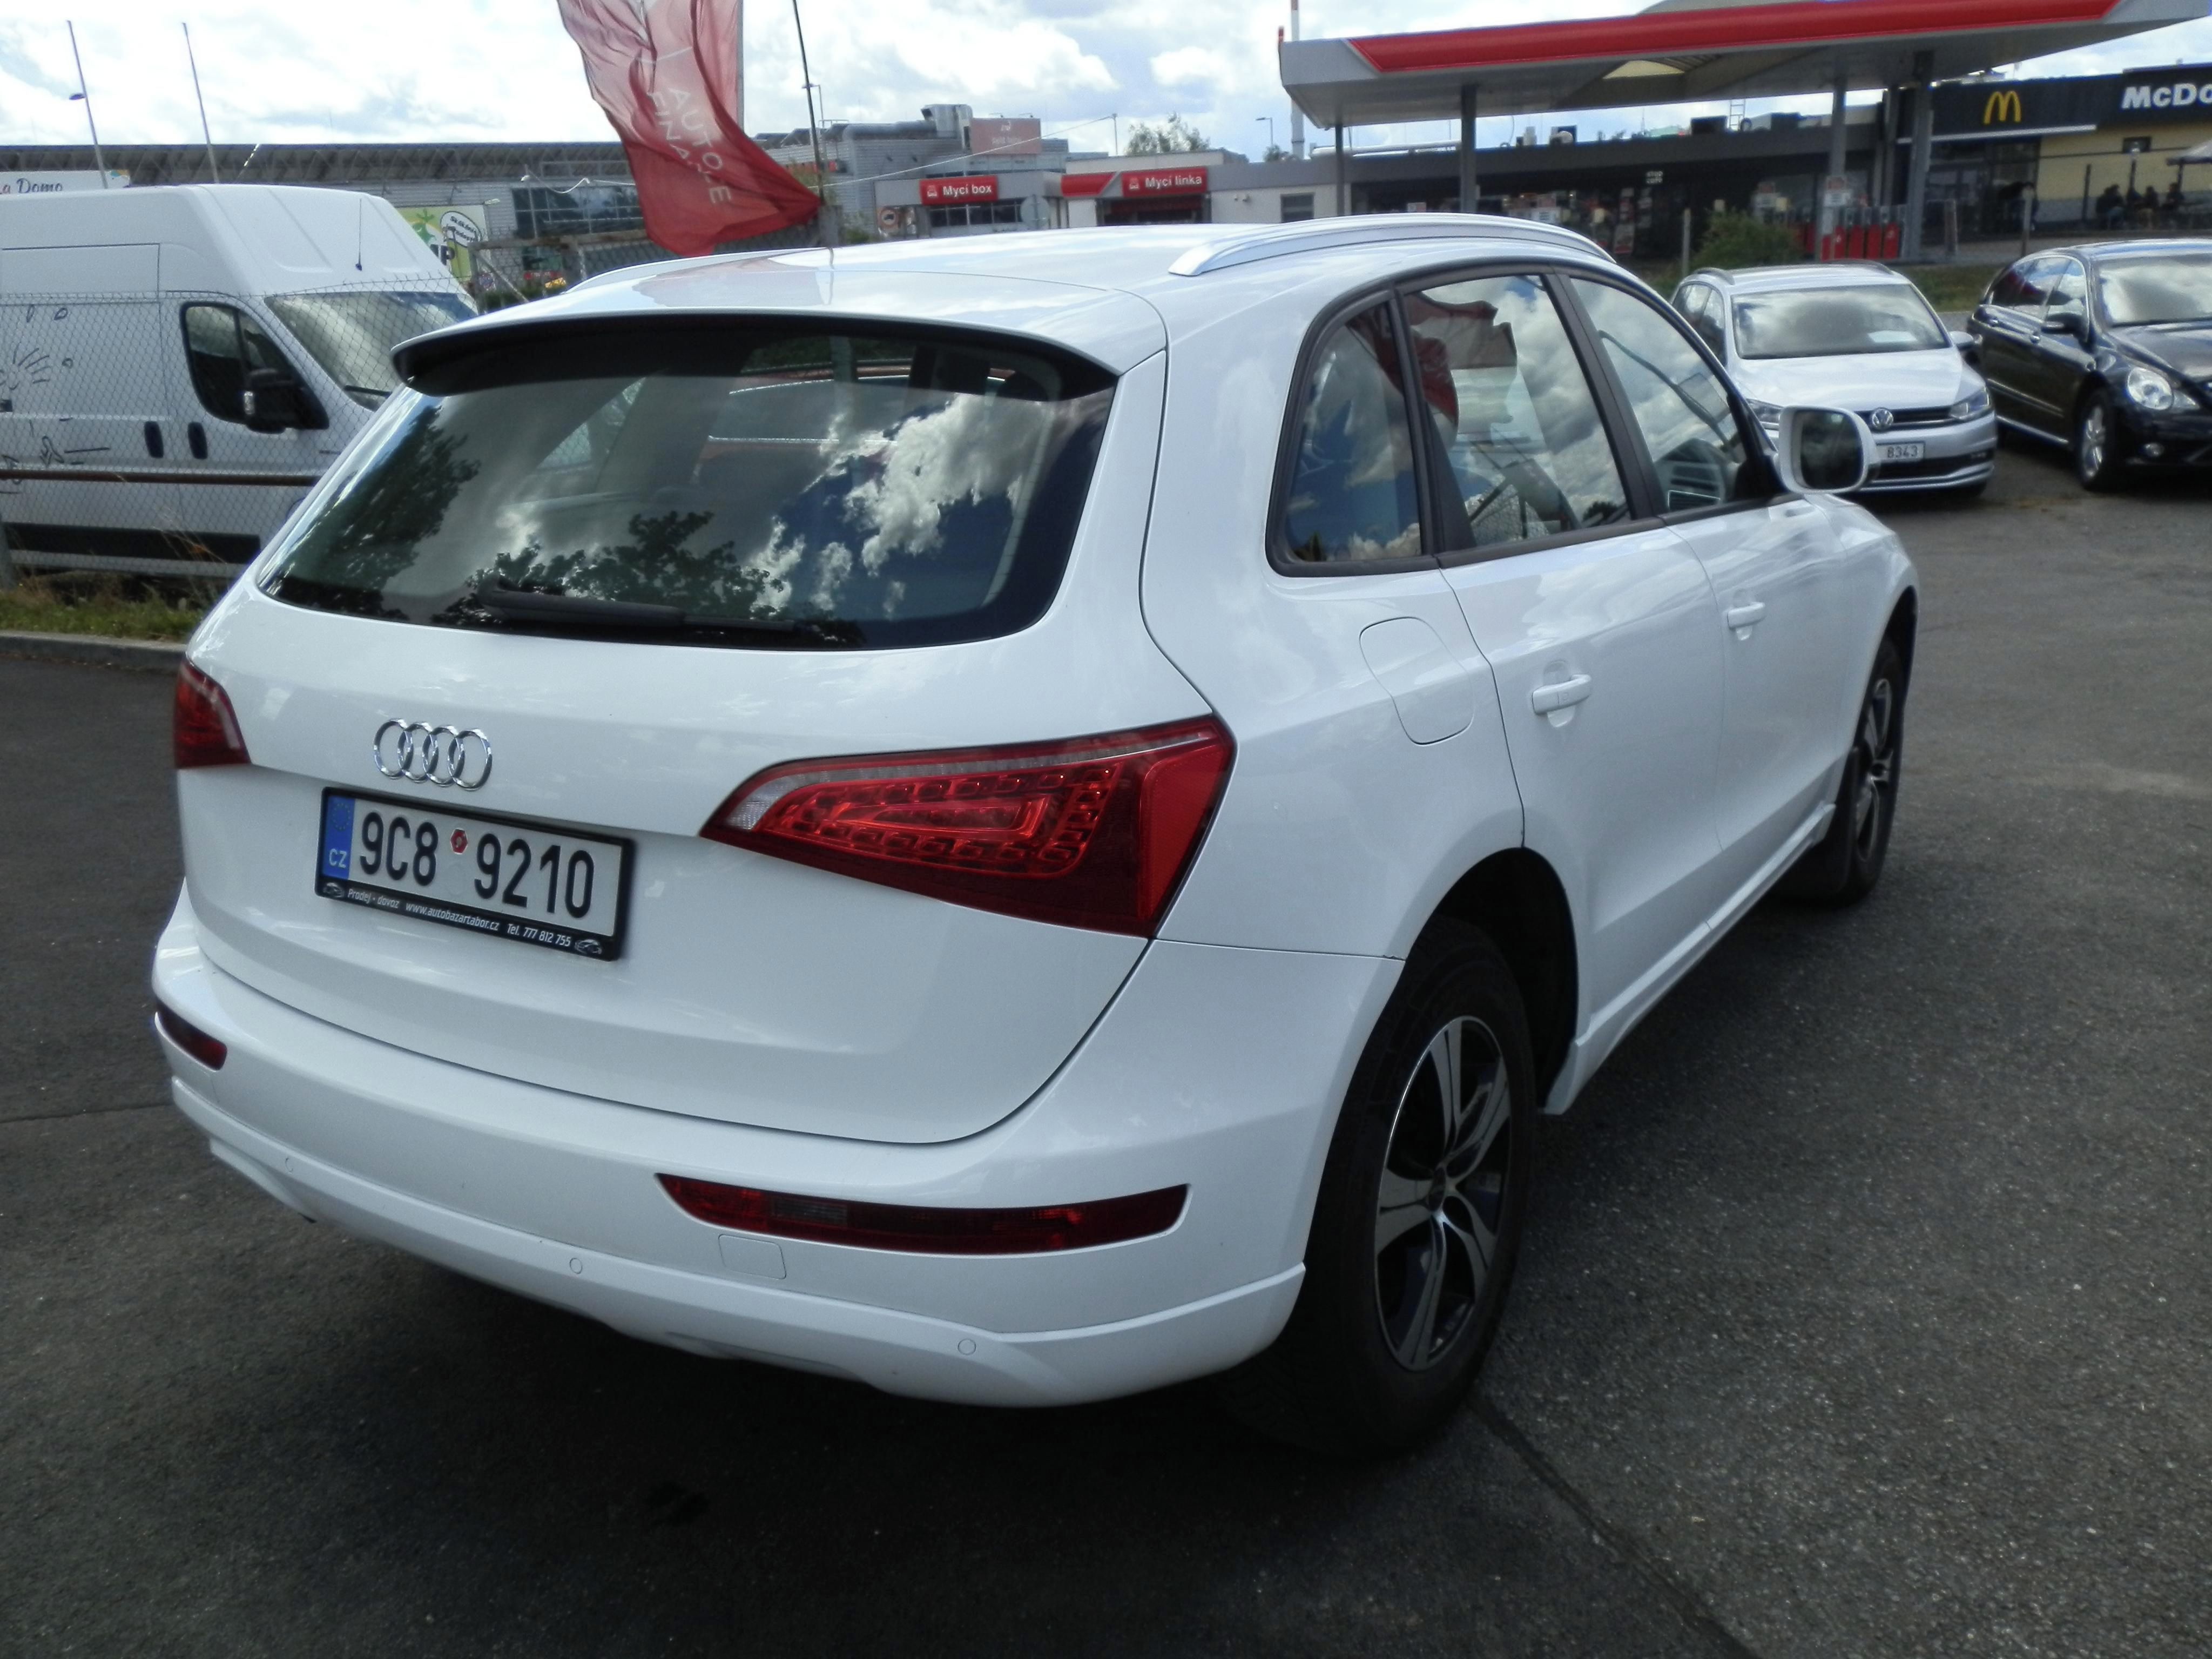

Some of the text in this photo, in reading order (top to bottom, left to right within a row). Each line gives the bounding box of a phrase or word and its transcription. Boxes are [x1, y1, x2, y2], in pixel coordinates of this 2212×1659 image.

[972, 184, 992, 194] box
[1175, 174, 1202, 186] linka
[329, 847, 347, 868] CZ
[360, 812, 595, 919] 9C8 9210
[347, 888, 372, 904] Prodej
[377, 895, 400, 909] dovoz
[406, 902, 500, 931] www.autobazartabor.cz
[507, 923, 520, 936] Tel.
[523, 927, 538, 939] 777
[539, 930, 554, 943] 812
[555, 934, 571, 947] 755
